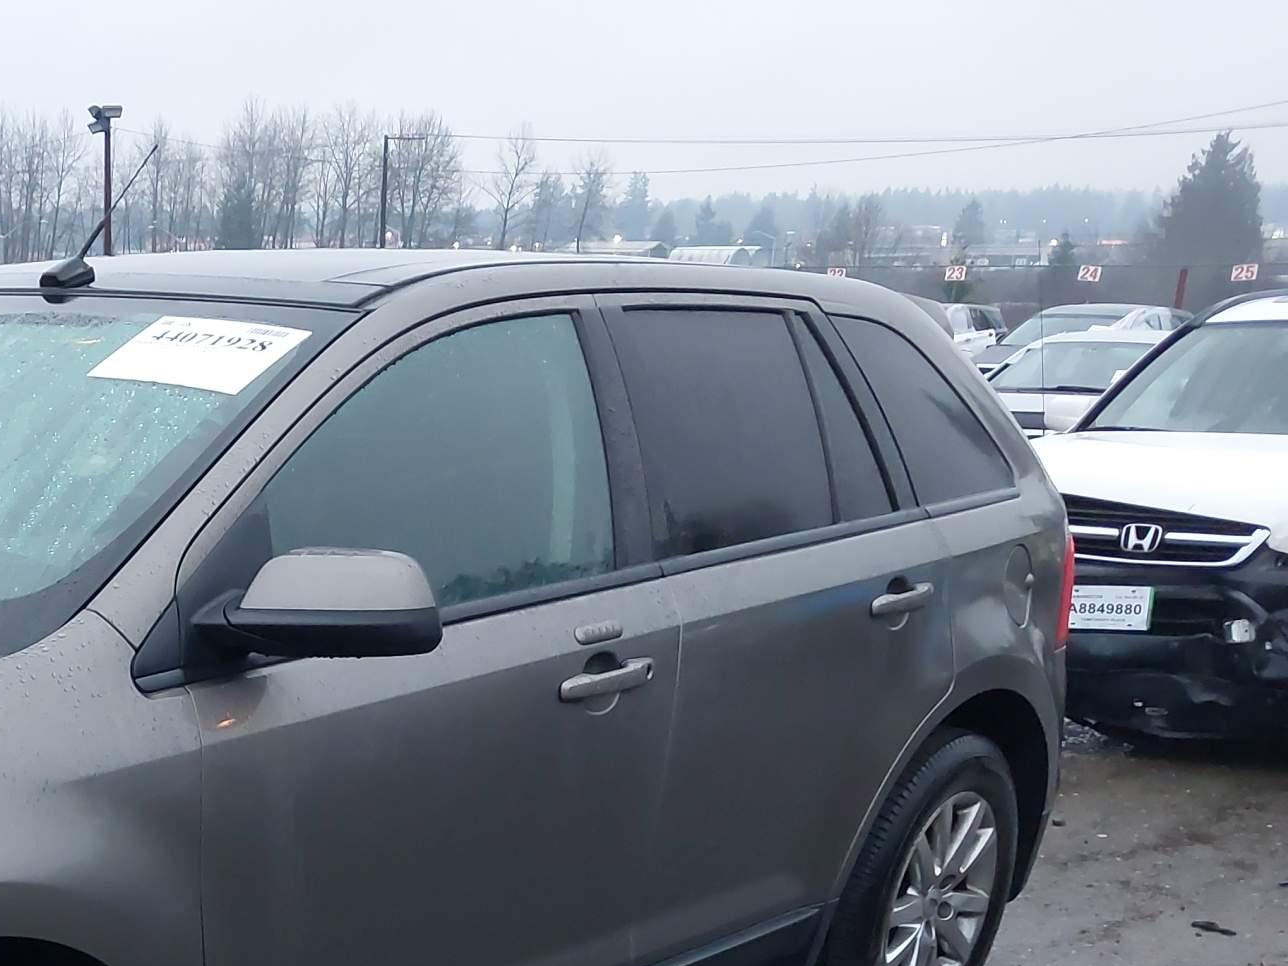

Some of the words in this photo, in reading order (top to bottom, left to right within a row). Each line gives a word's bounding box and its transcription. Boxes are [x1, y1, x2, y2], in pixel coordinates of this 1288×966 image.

[946, 266, 965, 280] 23
[1079, 267, 1100, 281] 24
[1233, 267, 1255, 280] 25
[152, 329, 274, 352] 44071928
[1068, 602, 1142, 615] A8849880
